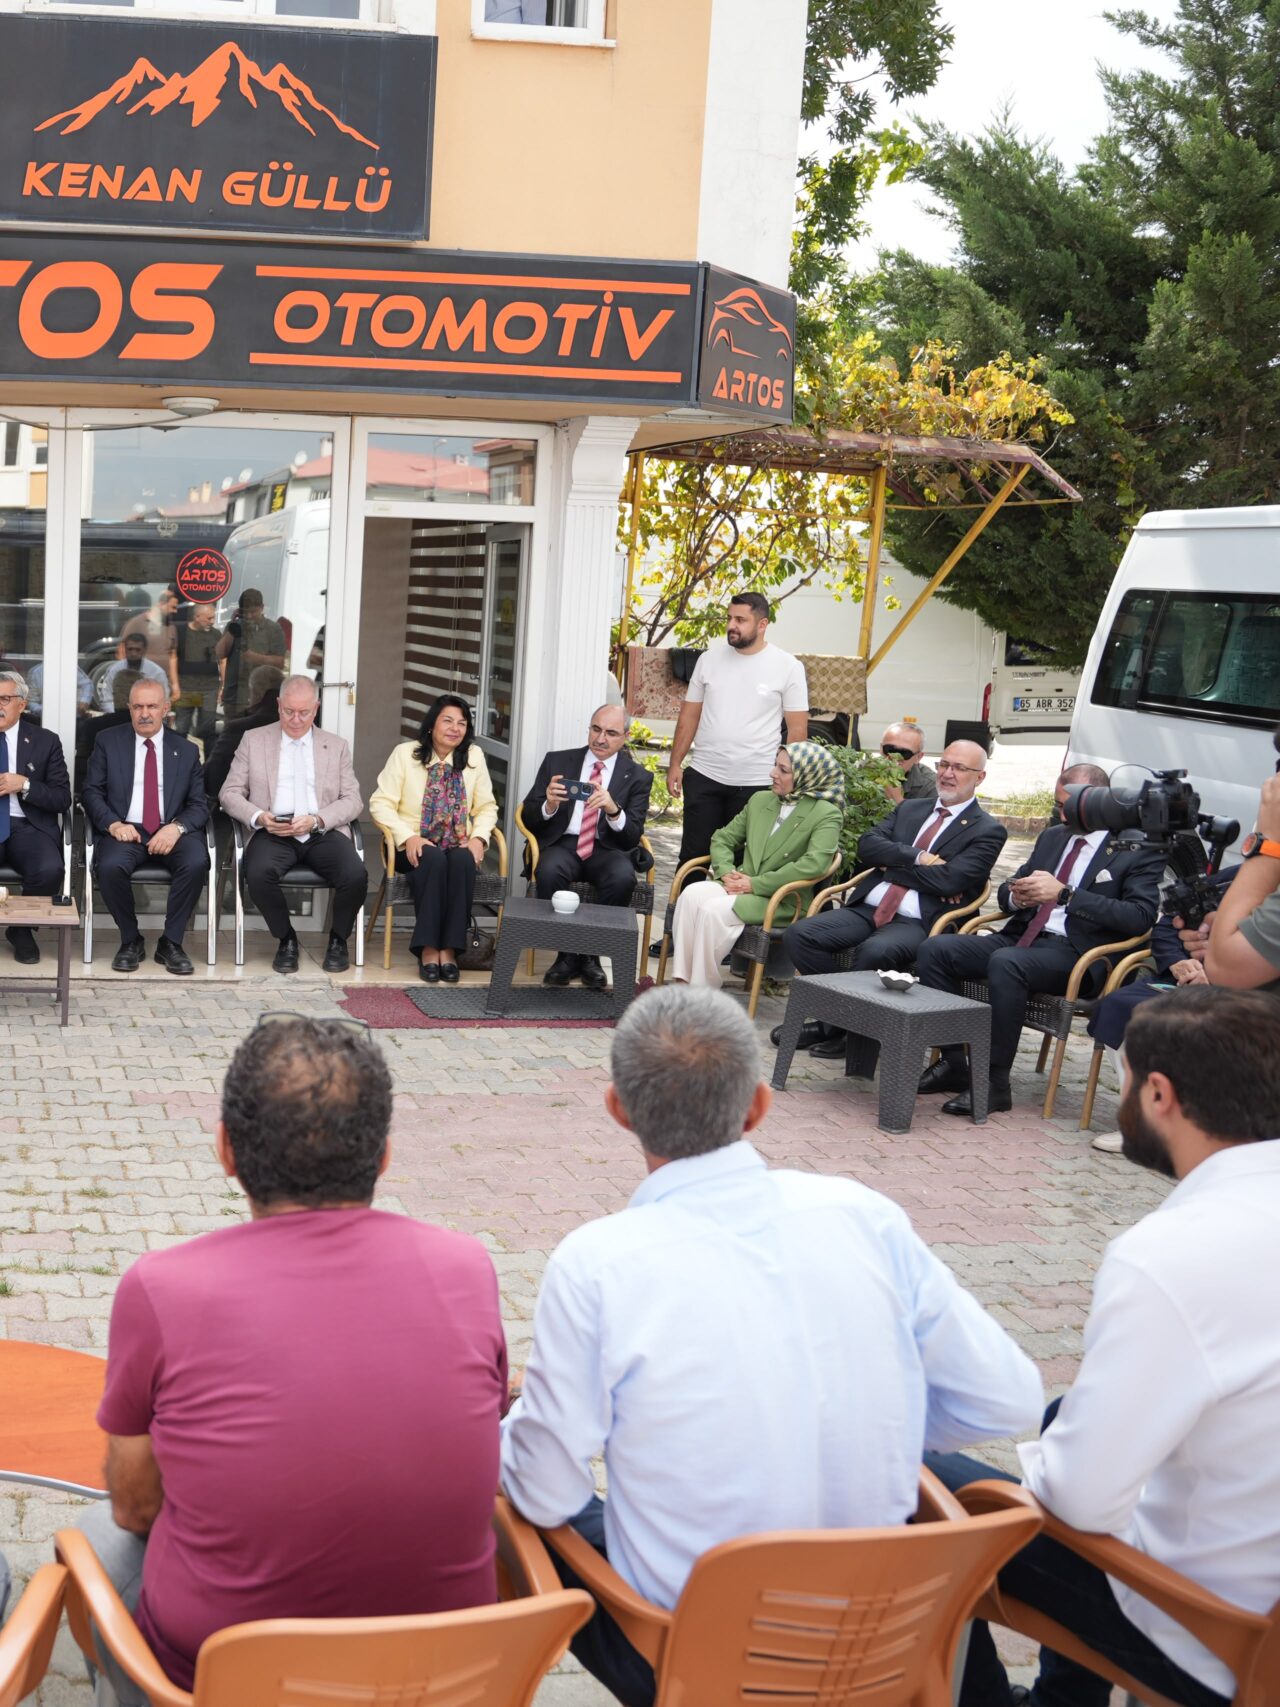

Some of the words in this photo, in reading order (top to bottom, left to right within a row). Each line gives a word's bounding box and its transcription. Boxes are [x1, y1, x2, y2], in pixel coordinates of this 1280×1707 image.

[22, 161, 203, 203] KENAN
[221, 160, 393, 213] GÜLLÜ
[273, 290, 677, 361] OTOMOTİV
[712, 366, 785, 410] ARTOS
[180, 569, 226, 582] ARTOS
[1020, 699, 1031, 708] 65
[1036, 699, 1053, 708] ABR
[1057, 699, 1074, 708] 352
